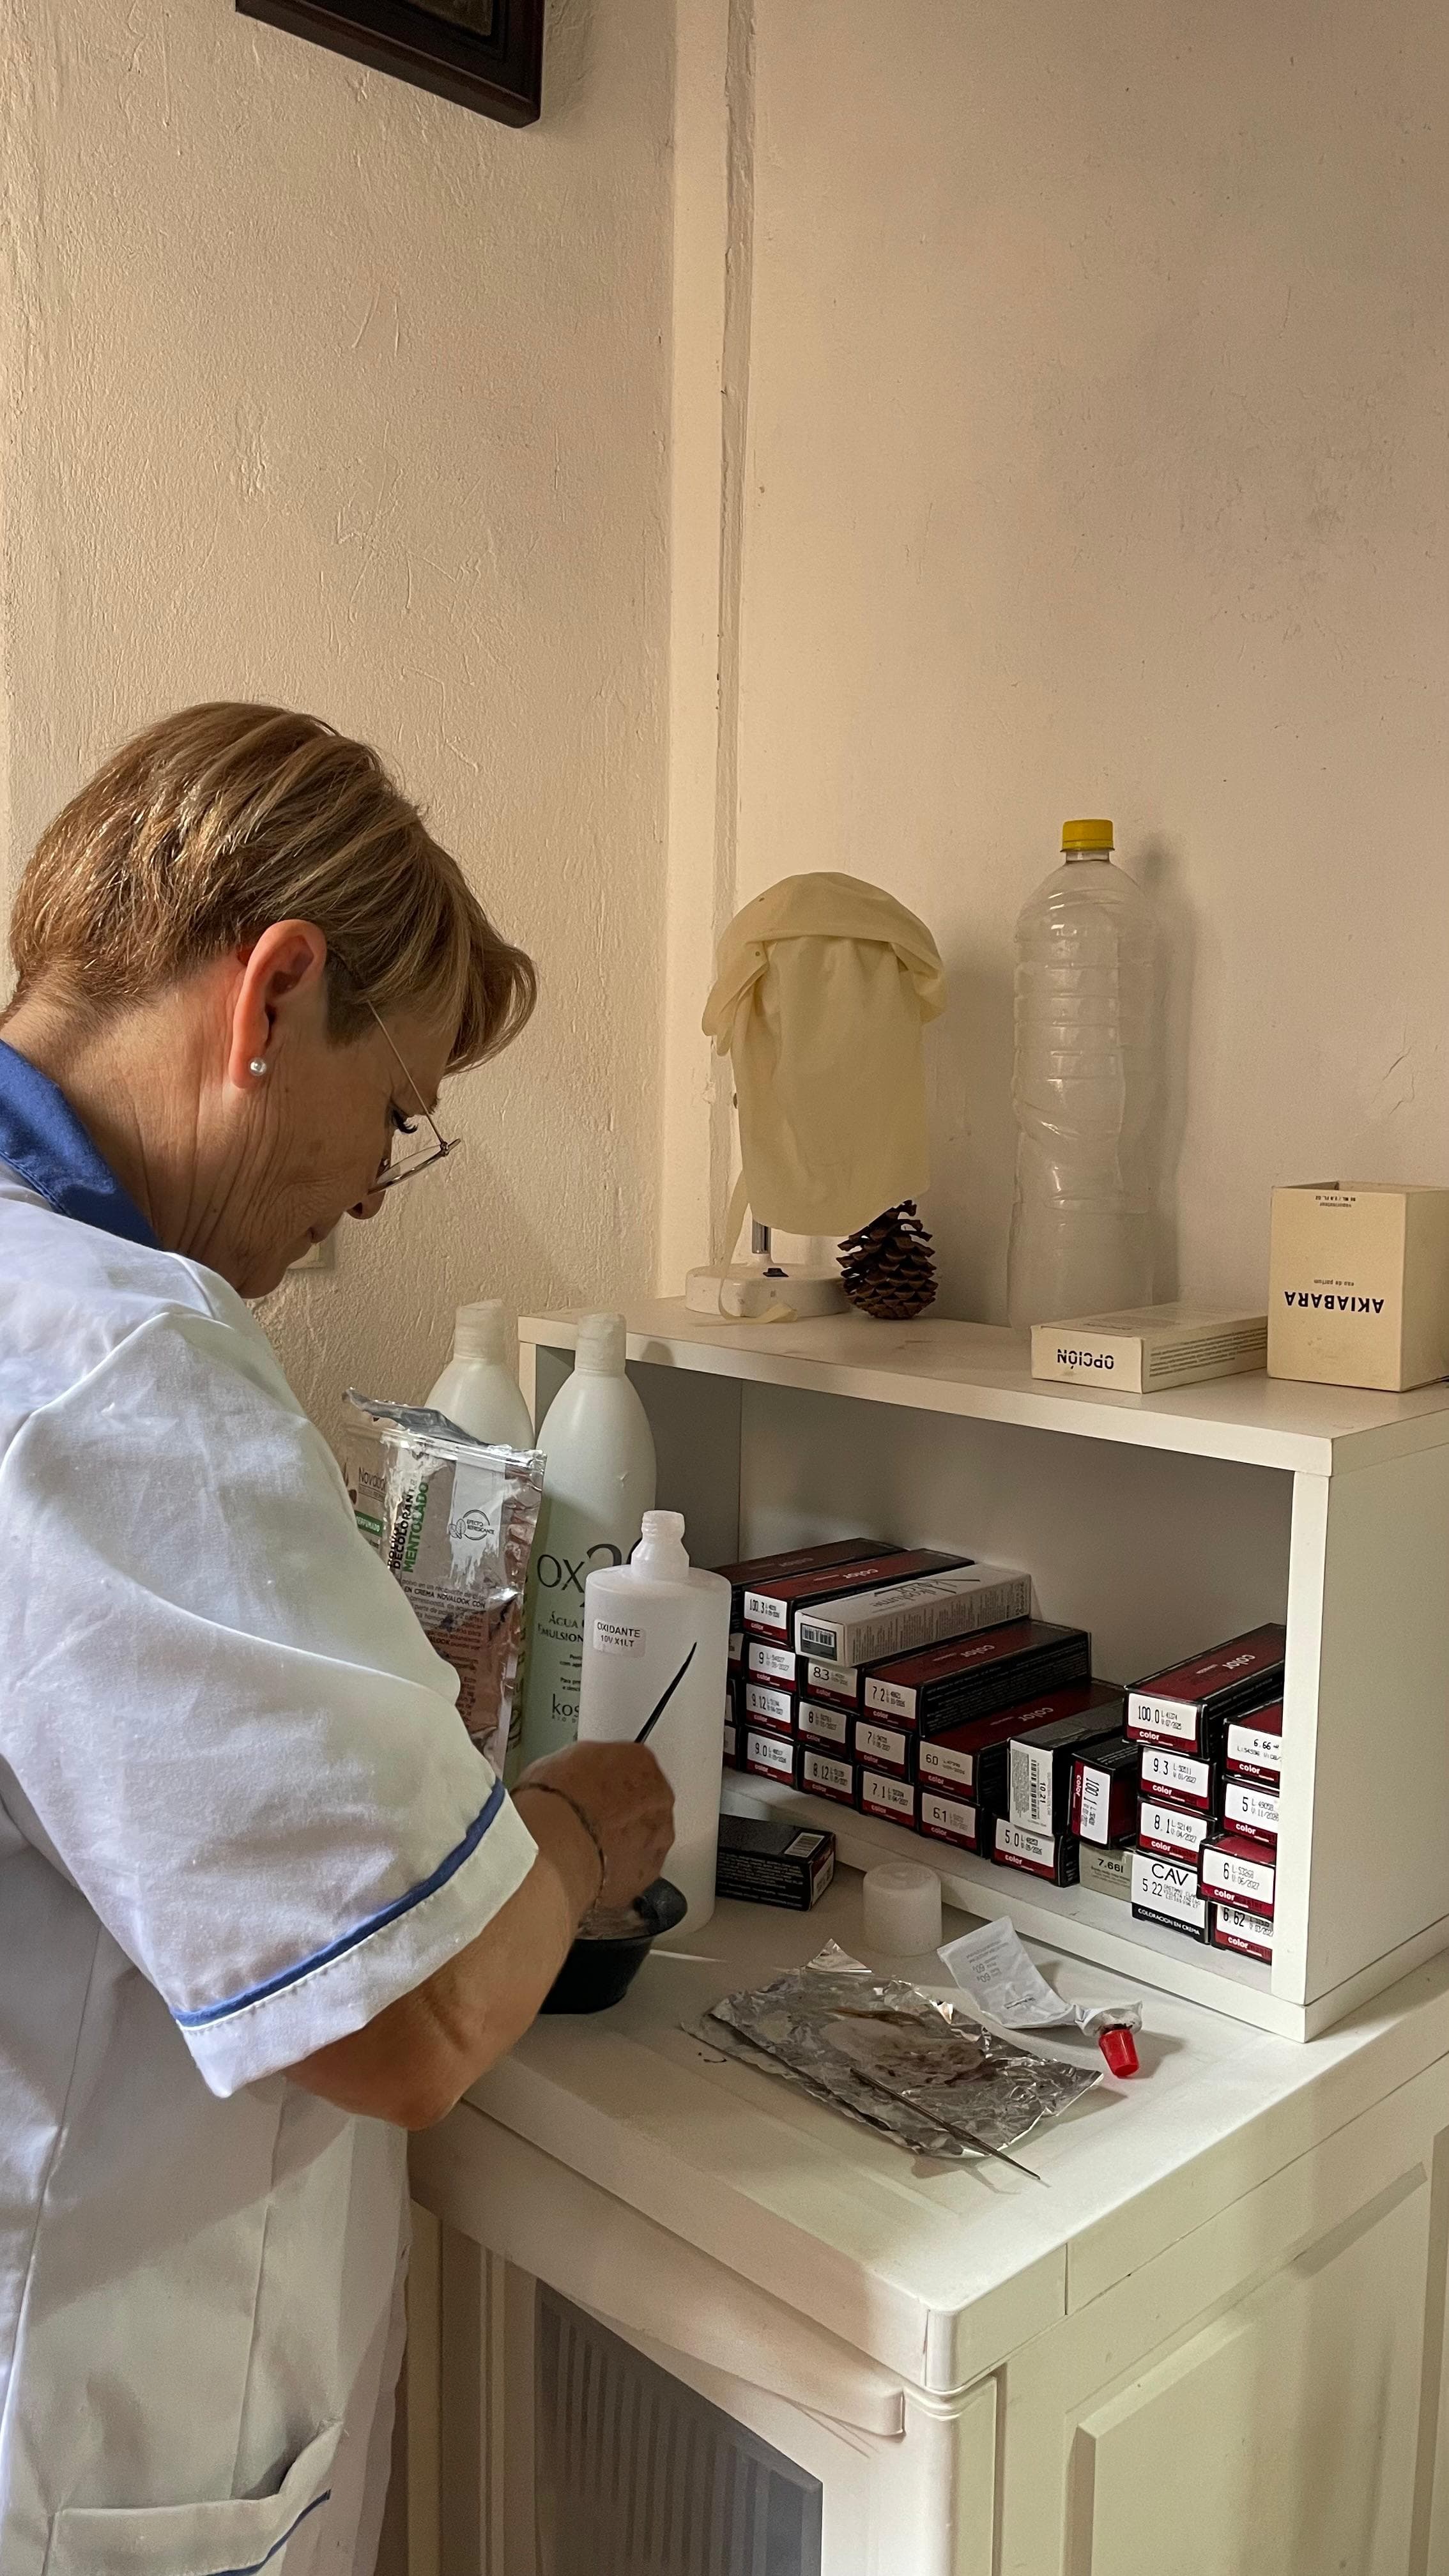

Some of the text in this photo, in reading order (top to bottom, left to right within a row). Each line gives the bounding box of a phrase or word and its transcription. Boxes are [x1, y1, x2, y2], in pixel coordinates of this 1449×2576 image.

[1284, 1291, 1384, 1314] AKIABARA
[1057, 1349, 1114, 1370] OPCIÓN
[401, 1482, 429, 1573] MENTOLADO
[842, 1568, 879, 1579] color
[414, 1588, 434, 1598] CREMA
[437, 1593, 470, 1606] NOVALOOK
[597, 1621, 641, 1638] OXIDANTE
[758, 1651, 765, 1664] 9
[960, 1644, 995, 1658] color
[1222, 1653, 1256, 1670] color
[808, 1711, 814, 1724] 8
[873, 1710, 889, 1720] color
[1018, 1706, 1054, 1722] color
[1138, 1705, 1160, 1724] 100.0
[867, 1730, 872, 1744] 7
[1139, 1730, 1160, 1741] color
[1254, 1738, 1271, 1751] 6.66
[1239, 1763, 1261, 1775] color
[928, 1774, 944, 1785] color
[1152, 1784, 1172, 1796] color
[871, 1804, 887, 1814] color
[1242, 1796, 1249, 1813] 5
[931, 1826, 947, 1837] color
[1236, 1823, 1256, 1836] color
[1151, 1840, 1171, 1852] color
[1005, 1854, 1022, 1865] color
[1151, 1863, 1189, 1886] CAV
[1223, 1862, 1230, 1880] 6
[1214, 1889, 1236, 1901] color
[1227, 1936, 1249, 1949] color
